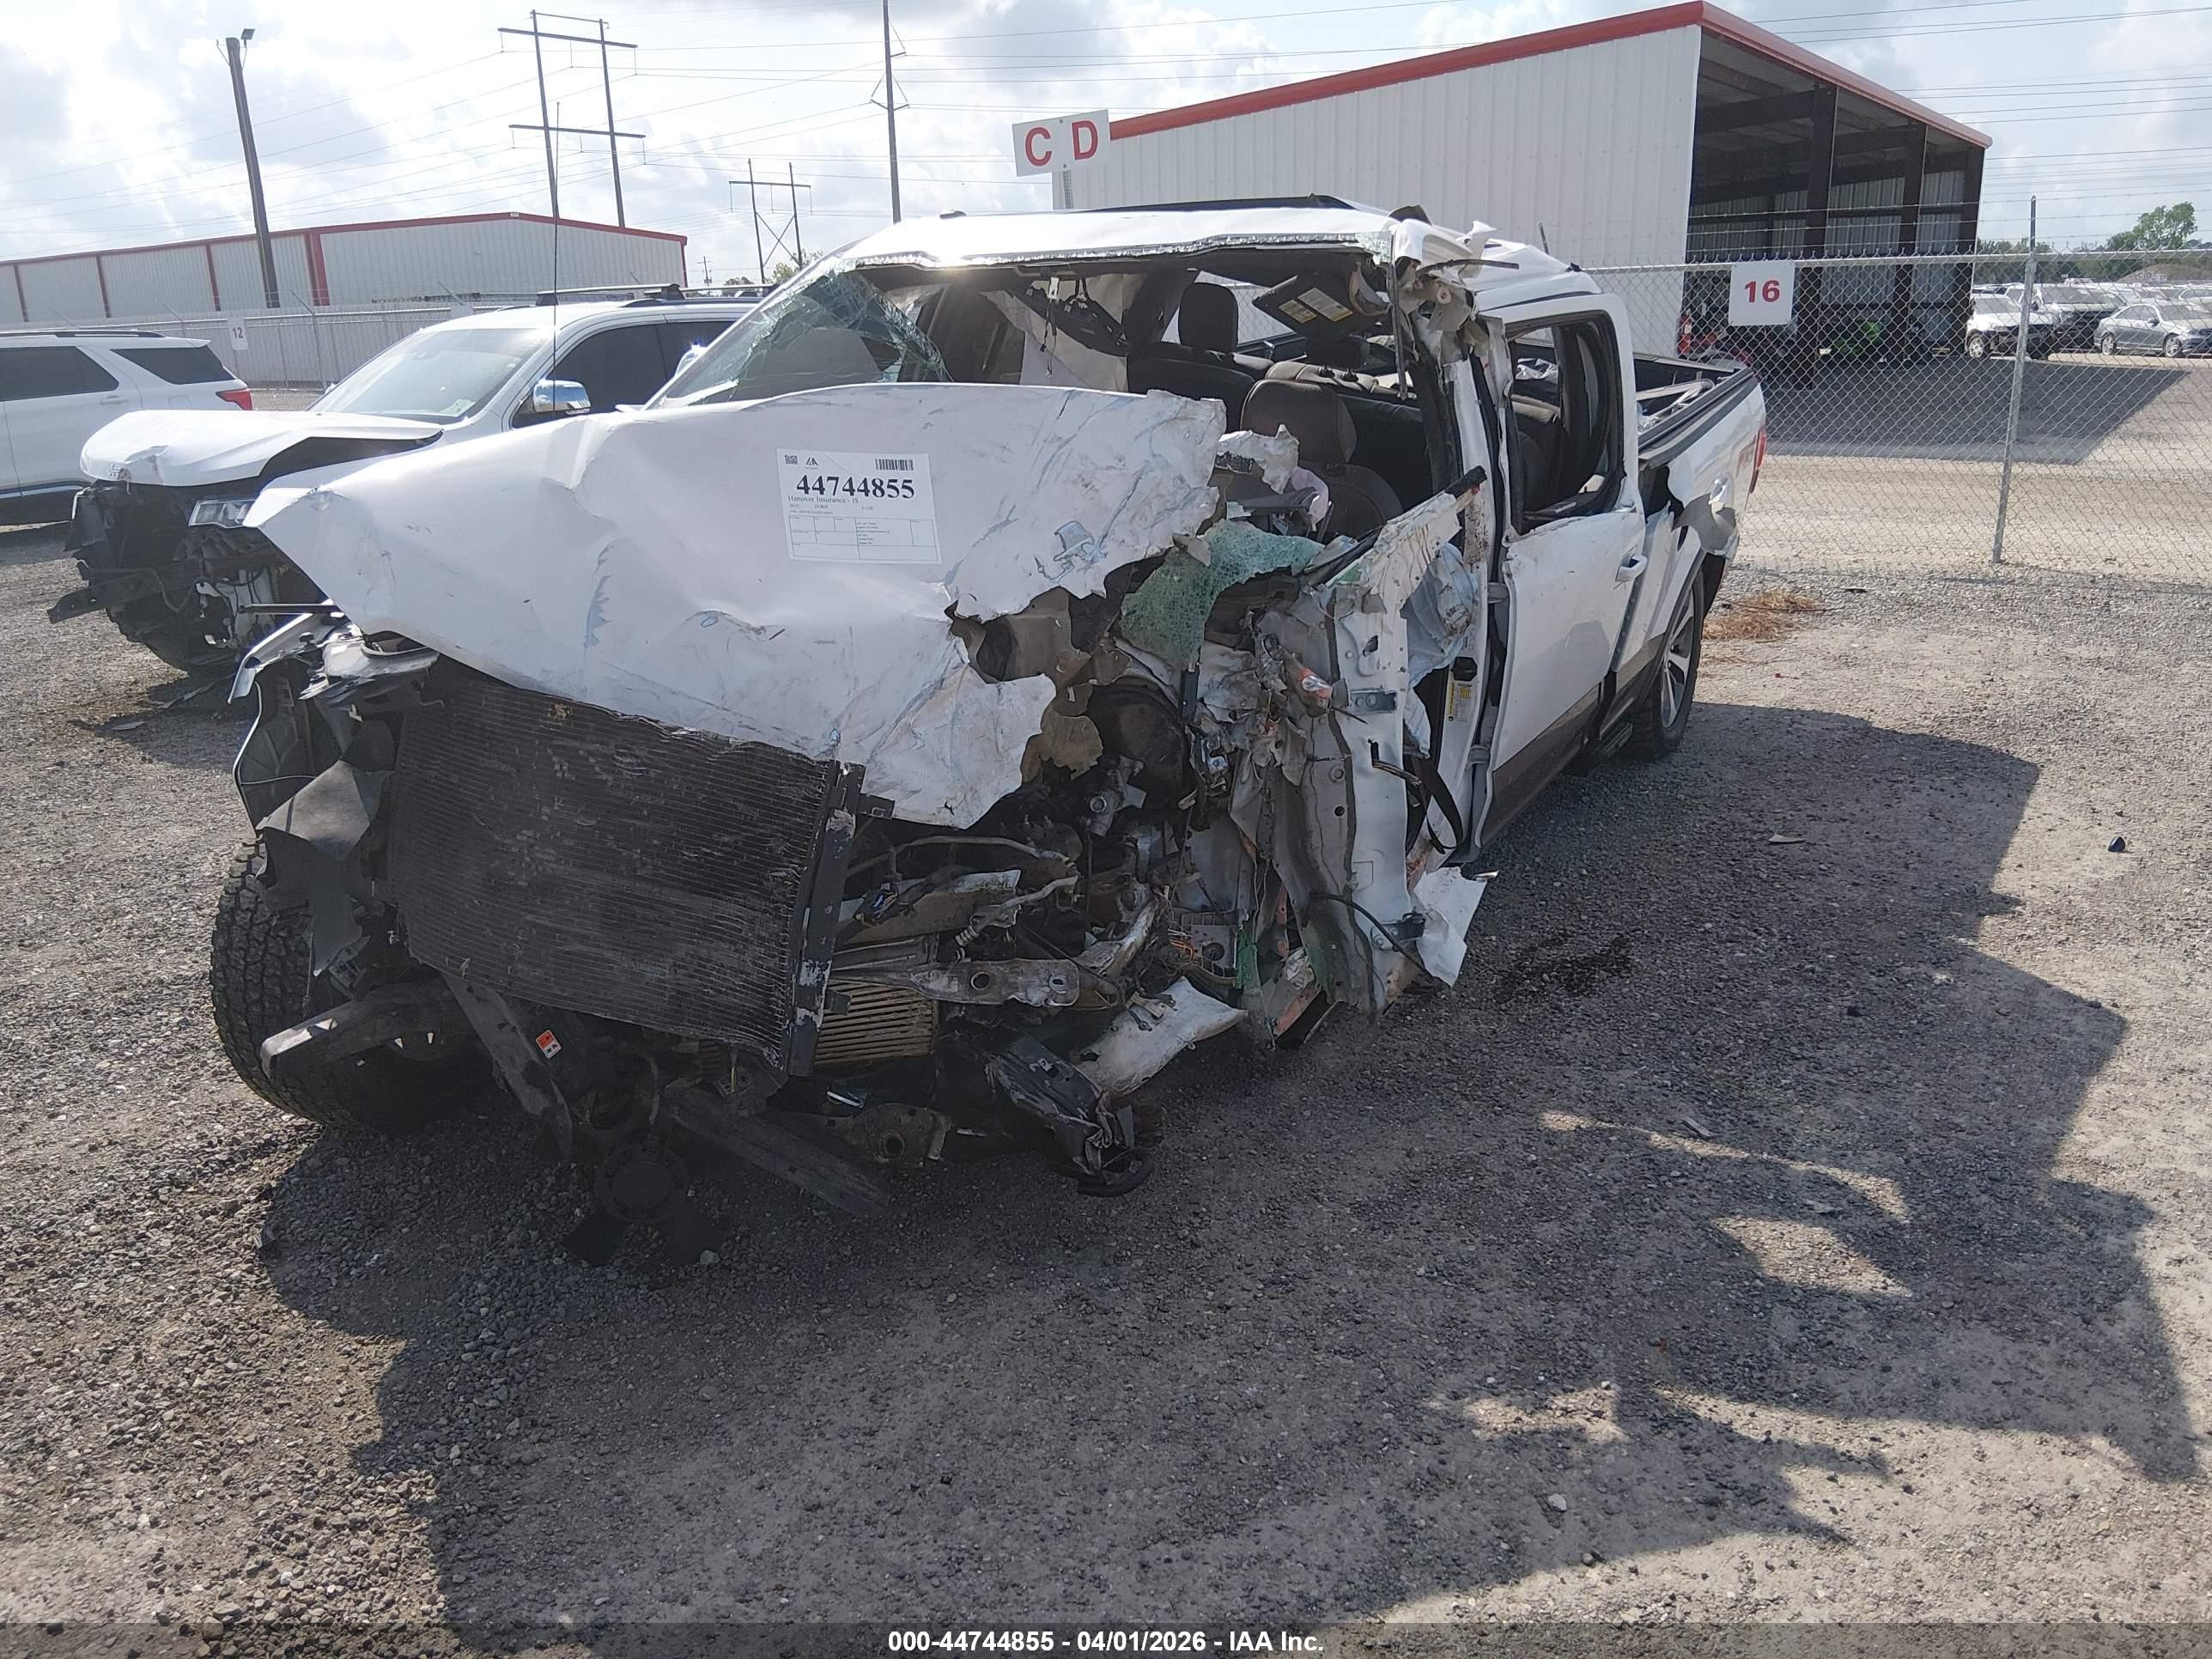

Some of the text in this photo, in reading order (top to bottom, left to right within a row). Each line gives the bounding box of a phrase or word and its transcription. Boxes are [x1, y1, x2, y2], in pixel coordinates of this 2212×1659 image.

[1024, 120, 1098, 167] C D
[1744, 279, 1780, 303] 16
[233, 326, 245, 338] 12
[796, 474, 915, 499] 44744855
[816, 495, 846, 504] Insurance
